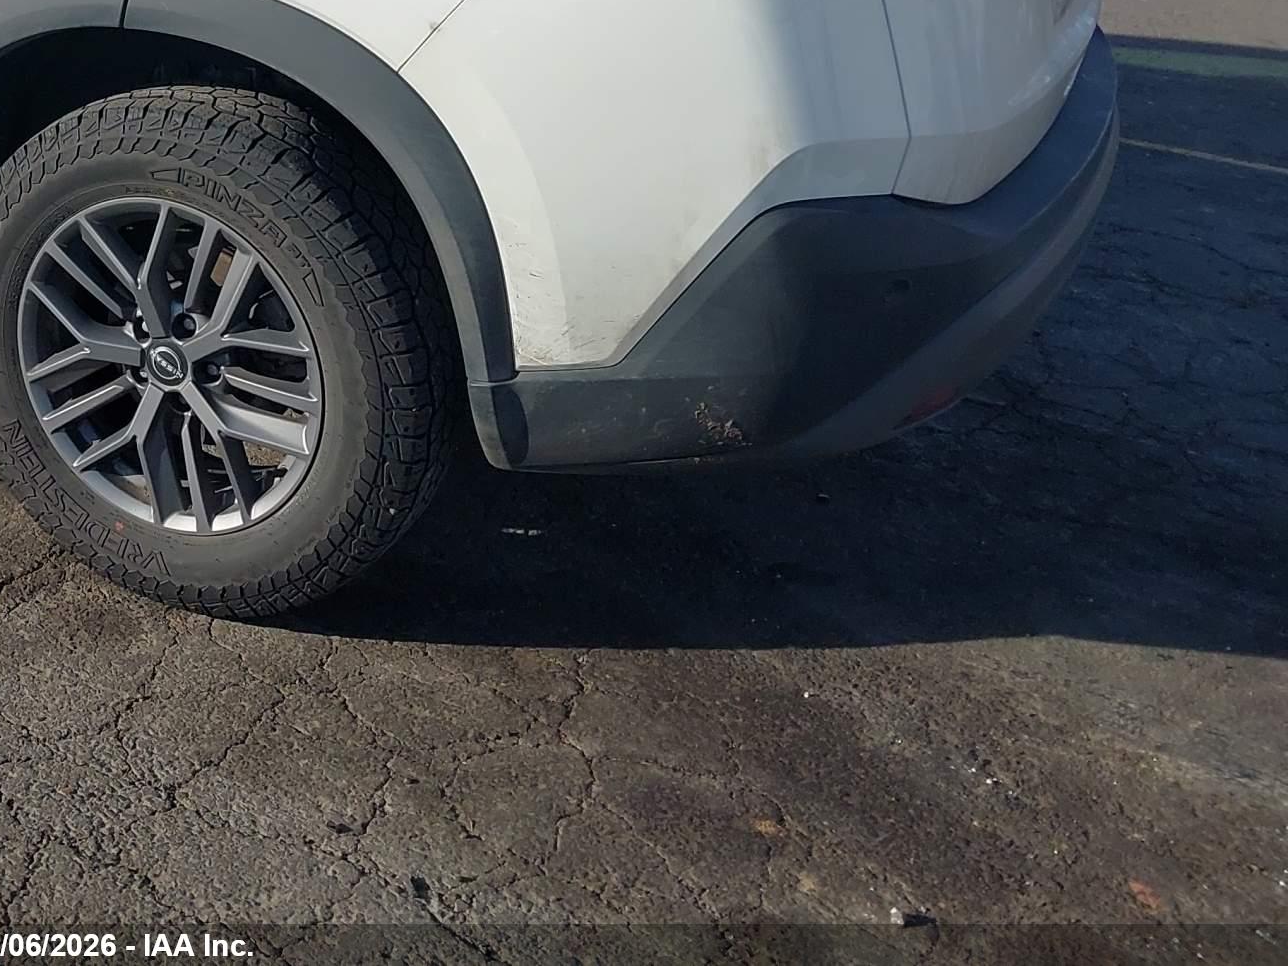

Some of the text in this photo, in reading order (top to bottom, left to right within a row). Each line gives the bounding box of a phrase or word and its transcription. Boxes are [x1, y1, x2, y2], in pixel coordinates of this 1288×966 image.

[179, 166, 288, 248] PINZA
[149, 348, 185, 380] NISSAN
[0, 419, 172, 579] VREDESTEIN
